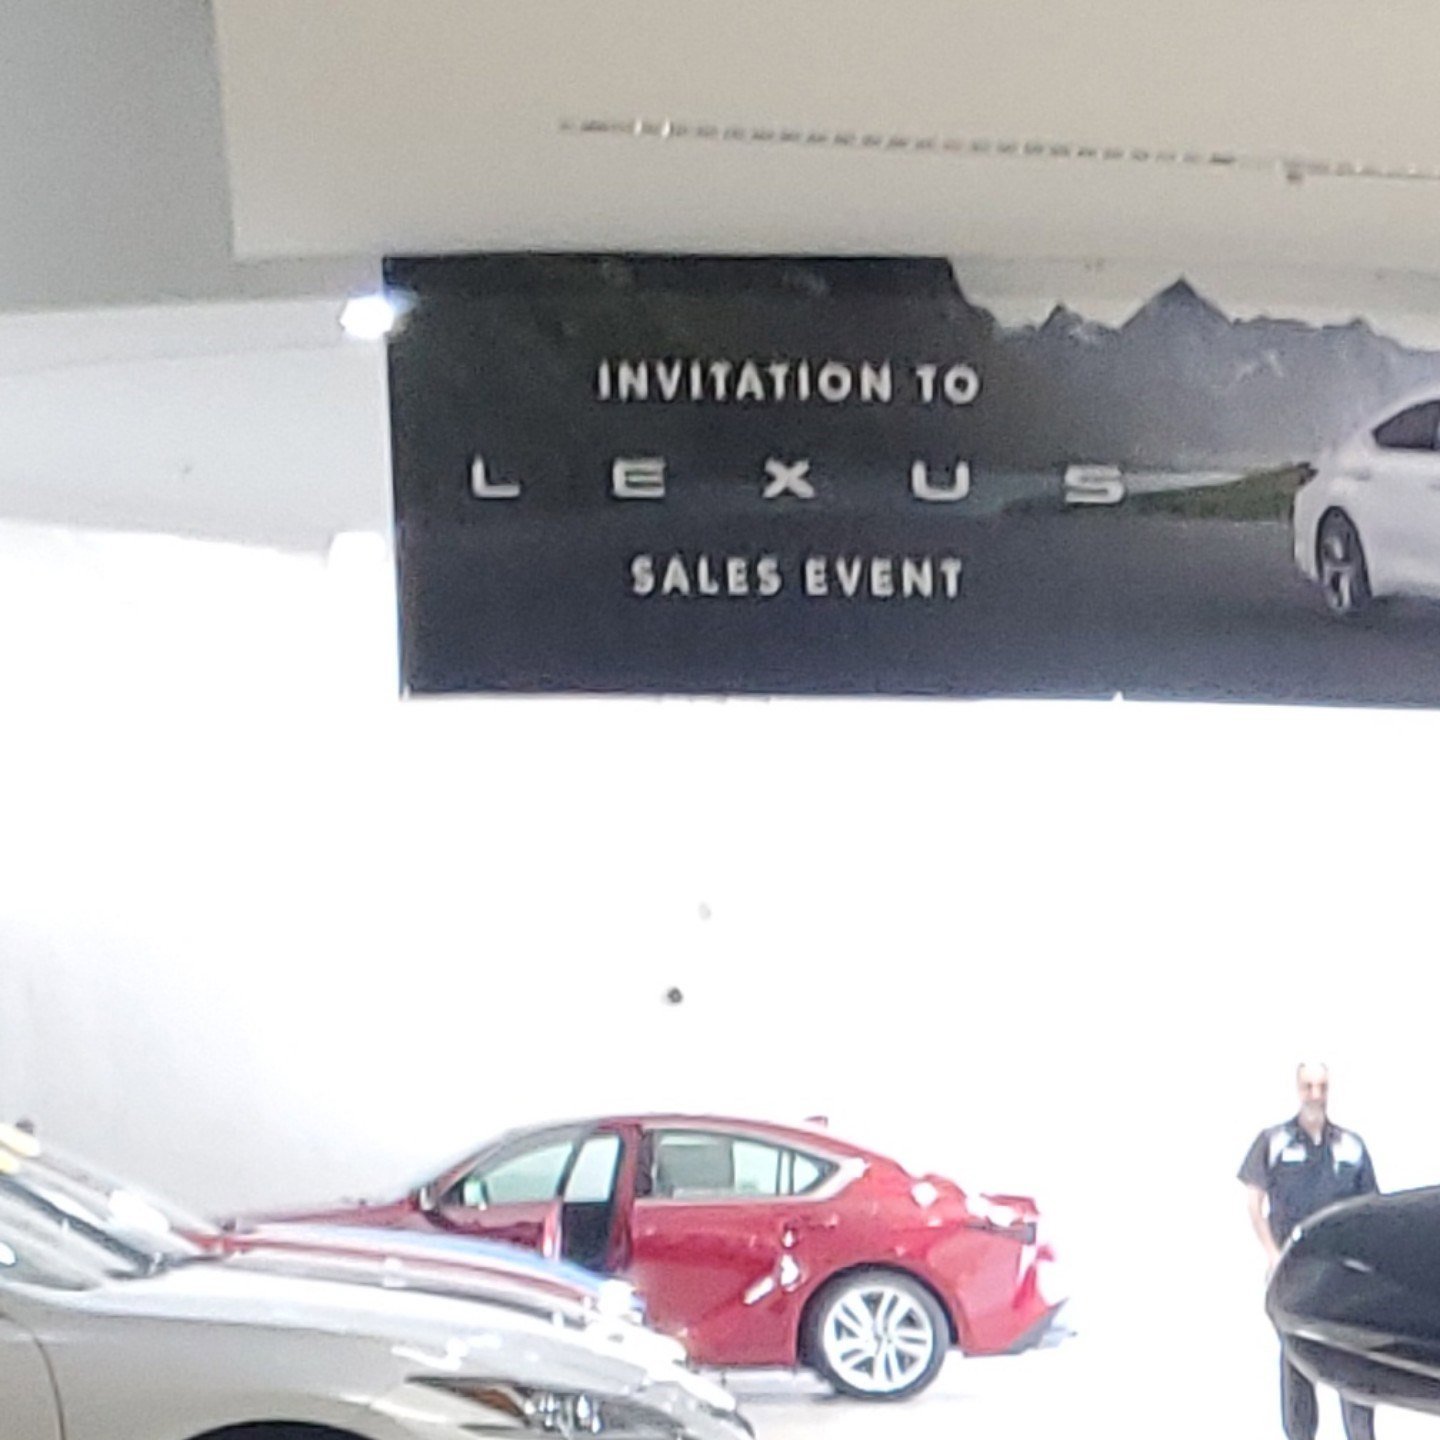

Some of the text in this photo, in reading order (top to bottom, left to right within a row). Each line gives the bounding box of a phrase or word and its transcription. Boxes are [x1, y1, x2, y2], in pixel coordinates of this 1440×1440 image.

[598, 358, 980, 405] INVITATION TO
[470, 455, 1126, 505] LEXUS
[629, 553, 963, 599] SALES EVENT
